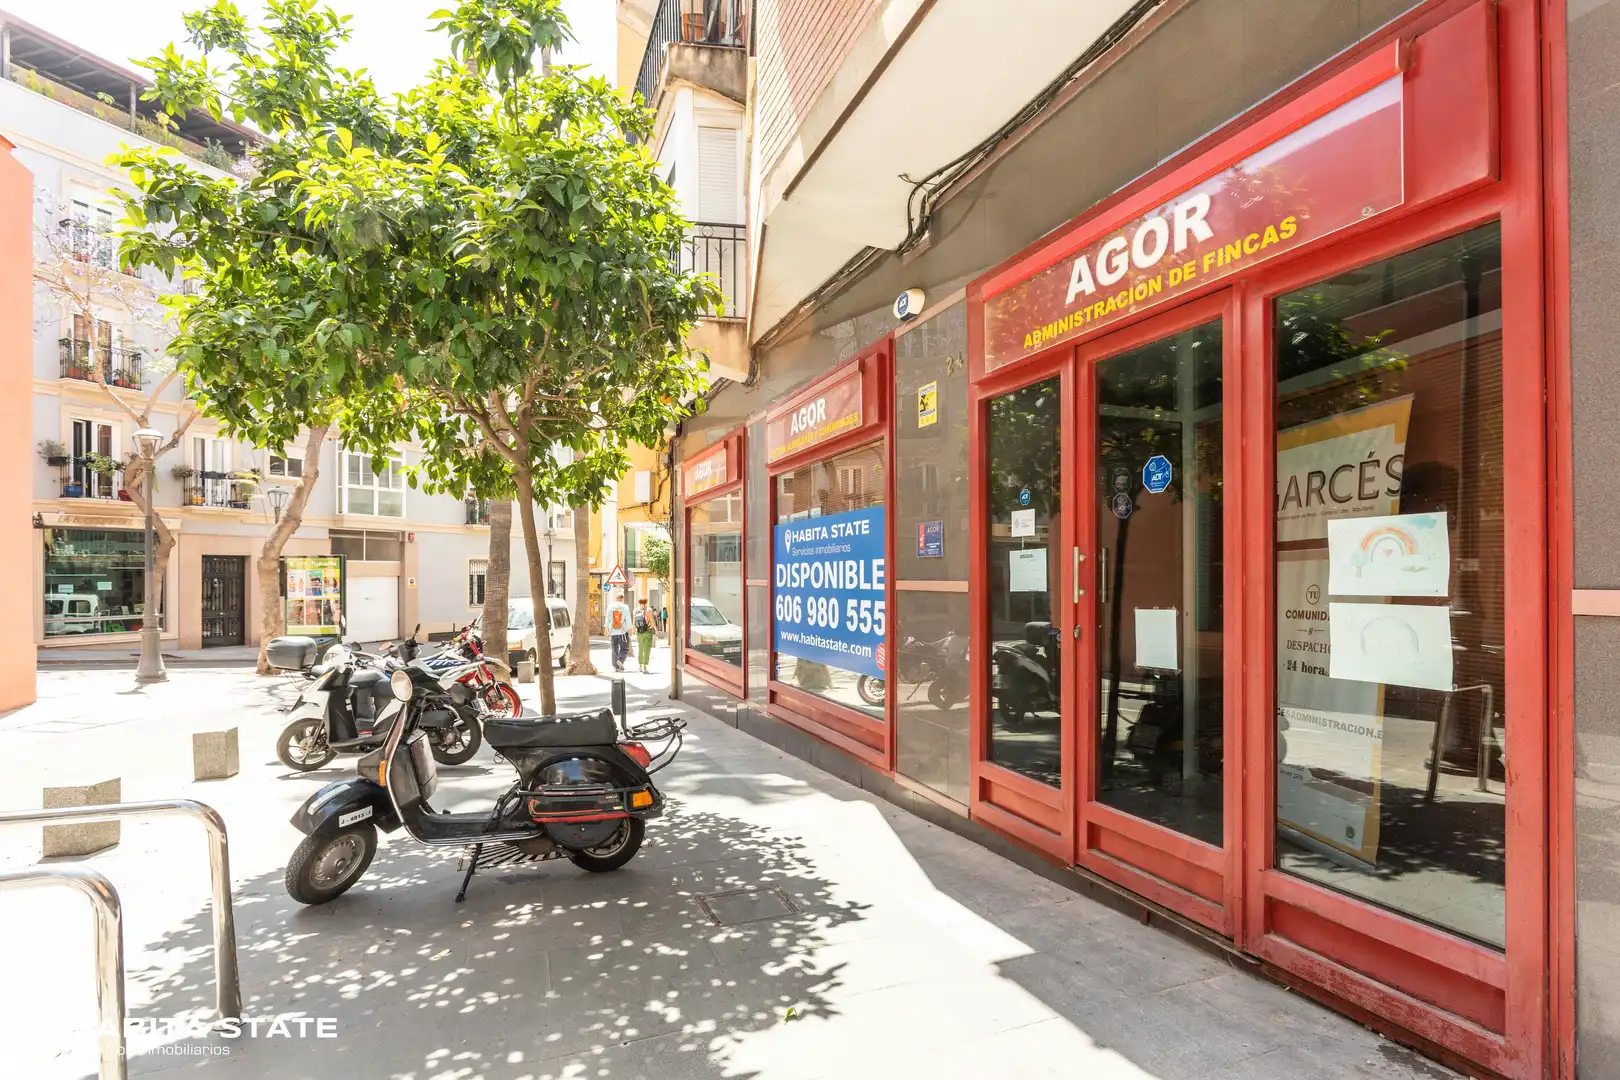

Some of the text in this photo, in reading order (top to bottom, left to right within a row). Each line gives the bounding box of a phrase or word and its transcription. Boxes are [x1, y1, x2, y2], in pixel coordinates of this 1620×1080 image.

[1065, 192, 1214, 305] AGOR
[1169, 260, 1196, 288] DE
[1203, 216, 1298, 274] FINCAS
[790, 398, 827, 436] AGOR
[695, 460, 712, 480] AGOR
[1277, 450, 1404, 512] ARCÉS
[792, 519, 870, 543] HABITA STATE
[792, 543, 851, 557] Servicios inmobiliarios
[776, 559, 885, 591] DISPONIBLE
[776, 594, 885, 636] 606 980 555
[1285, 609, 1330, 621] COMUNID
[780, 630, 872, 658] www.habitastate.com
[1308, 626, 1314, 635] y
[1286, 659, 1298, 671] 24
